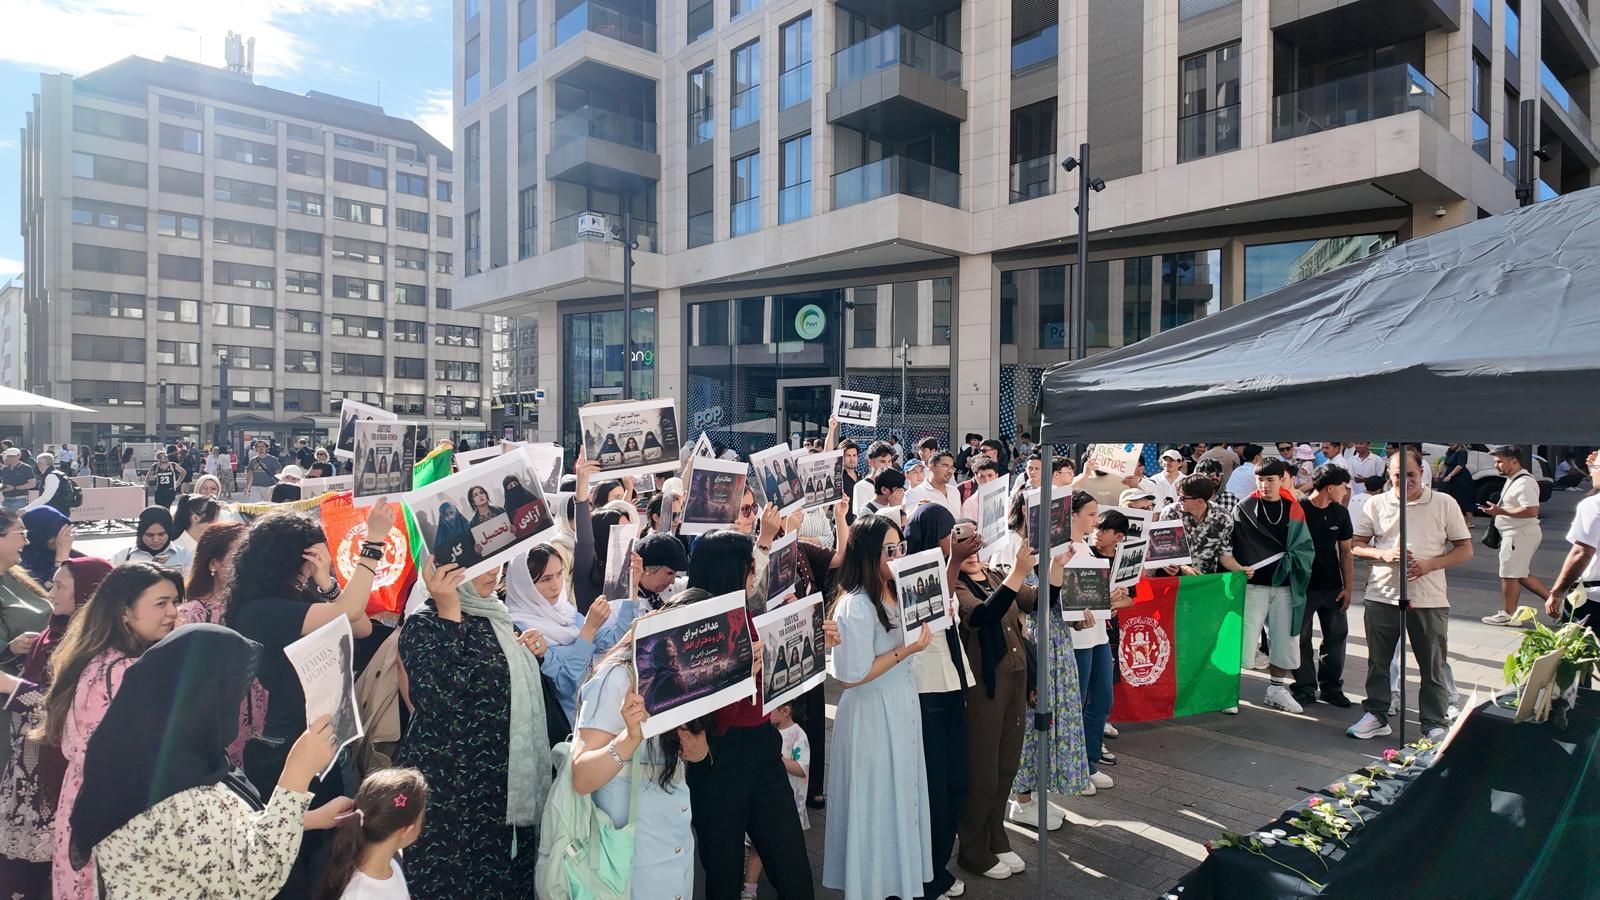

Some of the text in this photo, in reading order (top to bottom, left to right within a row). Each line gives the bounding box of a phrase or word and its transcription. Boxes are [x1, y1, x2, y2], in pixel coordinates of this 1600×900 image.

[694, 406, 723, 430] POP
[160, 476, 170, 485] 23
[519, 505, 541, 529] آزادی
[480, 522, 508, 546] تحصیل
[450, 543, 463, 562] کار
[682, 621, 719, 642] عدالت برای
[300, 648, 333, 675] FEMMES
